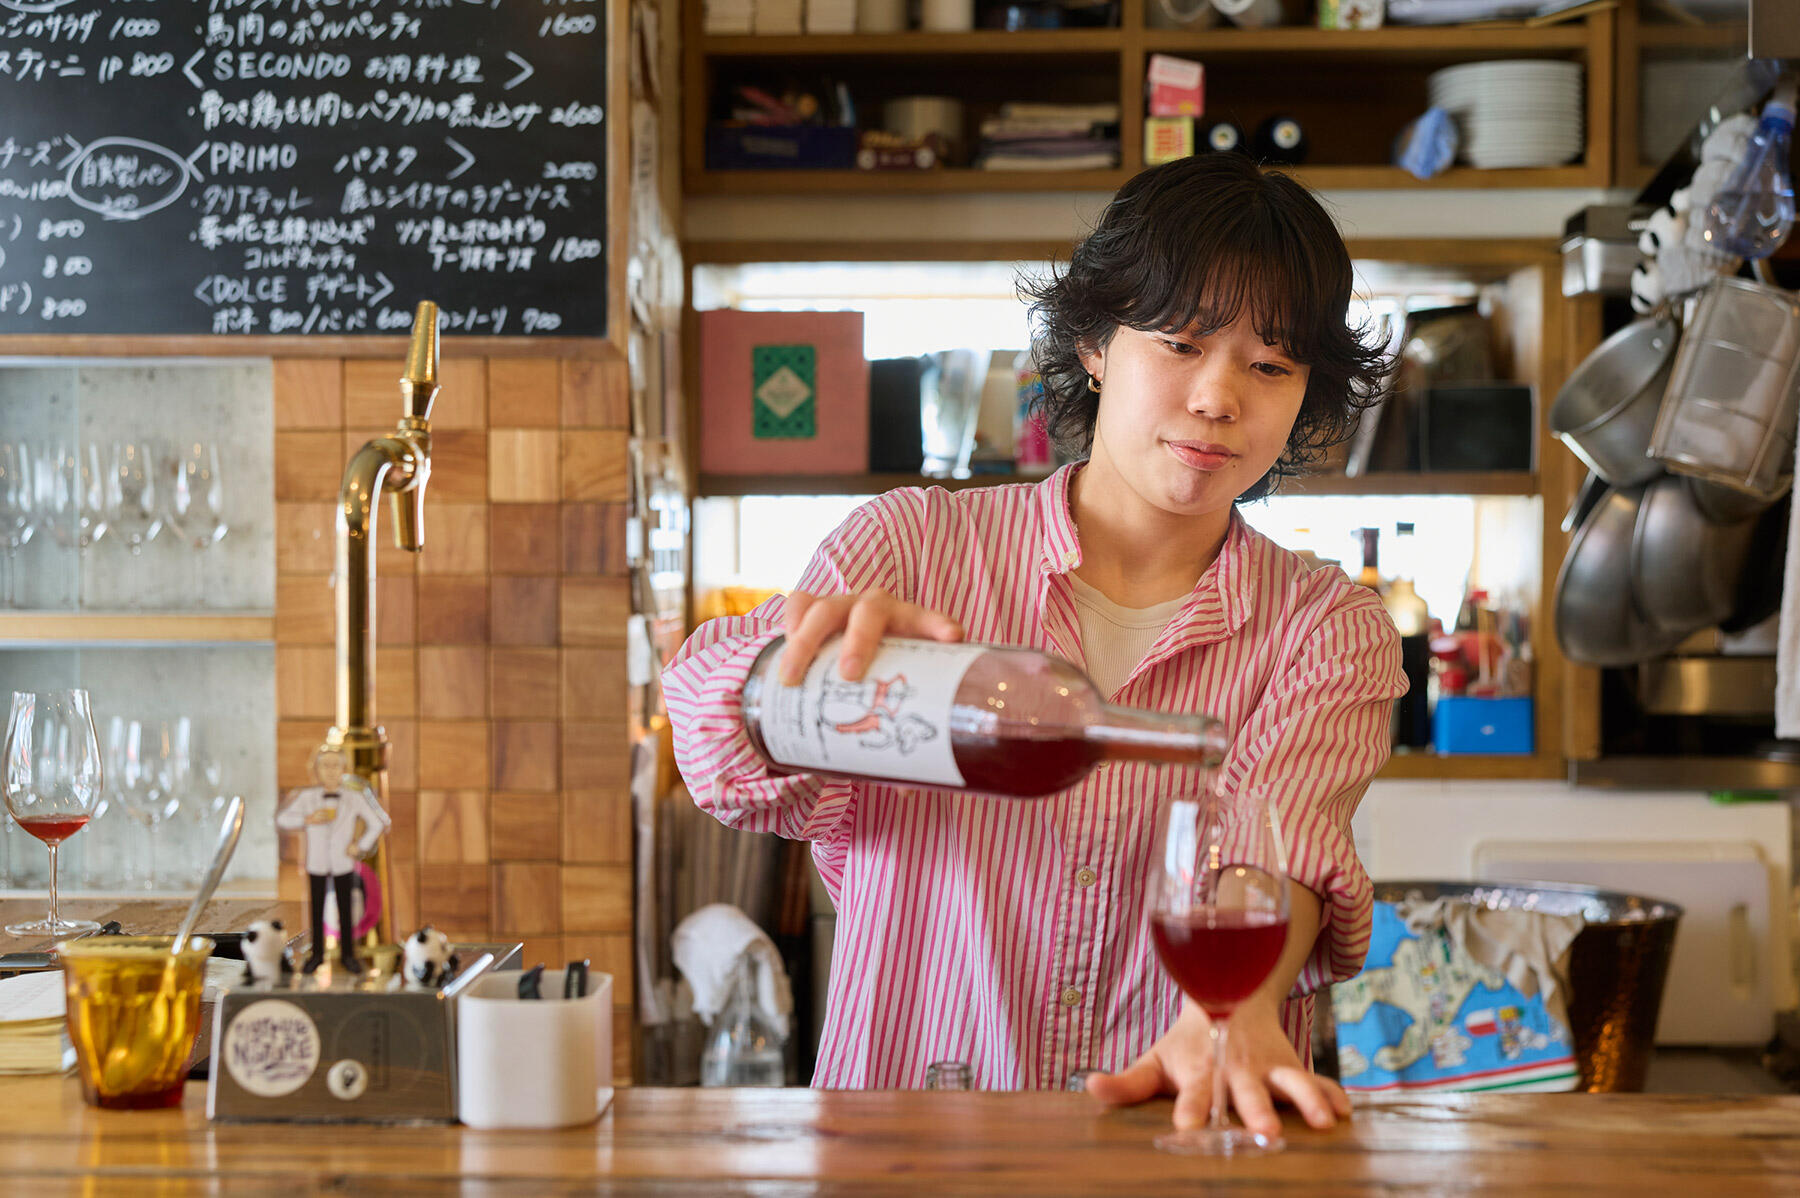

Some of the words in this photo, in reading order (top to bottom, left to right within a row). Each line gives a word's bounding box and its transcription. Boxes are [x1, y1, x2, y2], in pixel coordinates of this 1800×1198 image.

[109, 16, 161, 41] 1000
[538, 12, 597, 38] 1600
[129, 51, 175, 78] 800
[213, 50, 351, 81] SECONDO
[549, 100, 604, 128] 2600
[37, 218, 86, 242] 800
[549, 236, 602, 263] 1800
[41, 254, 93, 279] 800
[41, 296, 87, 321] 800
[375, 306, 413, 331] 600
[521, 307, 562, 335] 700
